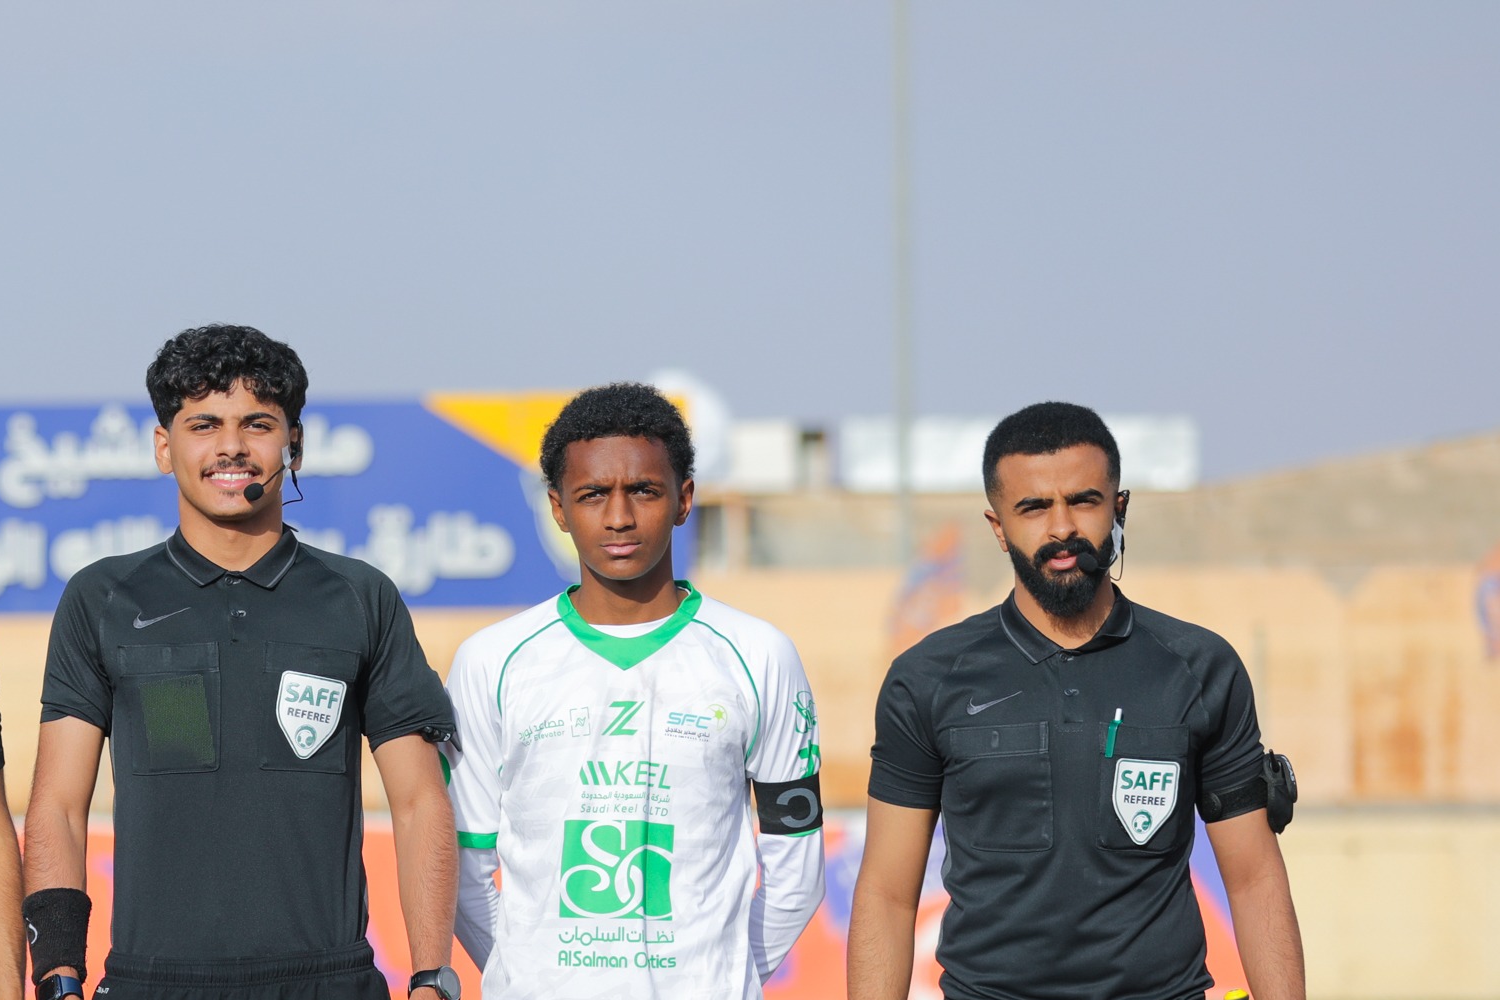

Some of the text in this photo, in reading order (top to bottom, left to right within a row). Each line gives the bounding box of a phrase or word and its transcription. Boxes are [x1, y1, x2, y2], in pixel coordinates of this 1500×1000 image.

[285, 682, 340, 709] SAFF
[287, 707, 331, 723] REFEREE
[666, 712, 712, 729] SFC
[533, 730, 565, 742] Elevator
[1120, 770, 1174, 791] SAFF
[1123, 794, 1166, 806] REFEREE
[580, 803, 609, 814] Saudi
[613, 803, 638, 813] Keel
[558, 950, 628, 968] AlSalman
